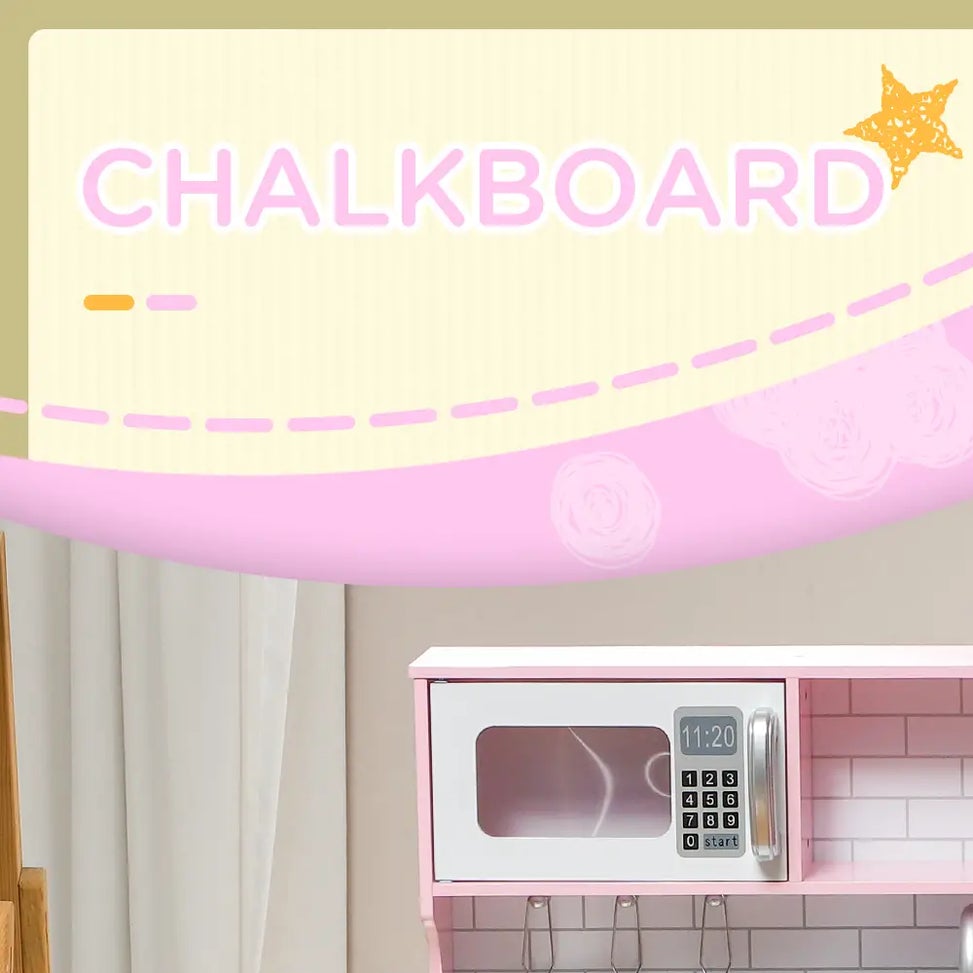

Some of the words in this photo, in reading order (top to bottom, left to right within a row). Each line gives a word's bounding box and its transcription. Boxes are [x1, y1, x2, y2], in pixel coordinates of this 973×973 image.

[682, 725, 735, 748] 11:20
[686, 773, 692, 785] 1
[705, 773, 714, 785] 2
[726, 773, 735, 785] 3
[686, 794, 694, 806] 4
[706, 794, 714, 806] 5
[726, 794, 735, 806] 6
[686, 814, 695, 826] 7
[706, 814, 715, 826] 8
[727, 814, 736, 826] 9
[686, 835, 695, 847] 0
[705, 836, 738, 847] start
